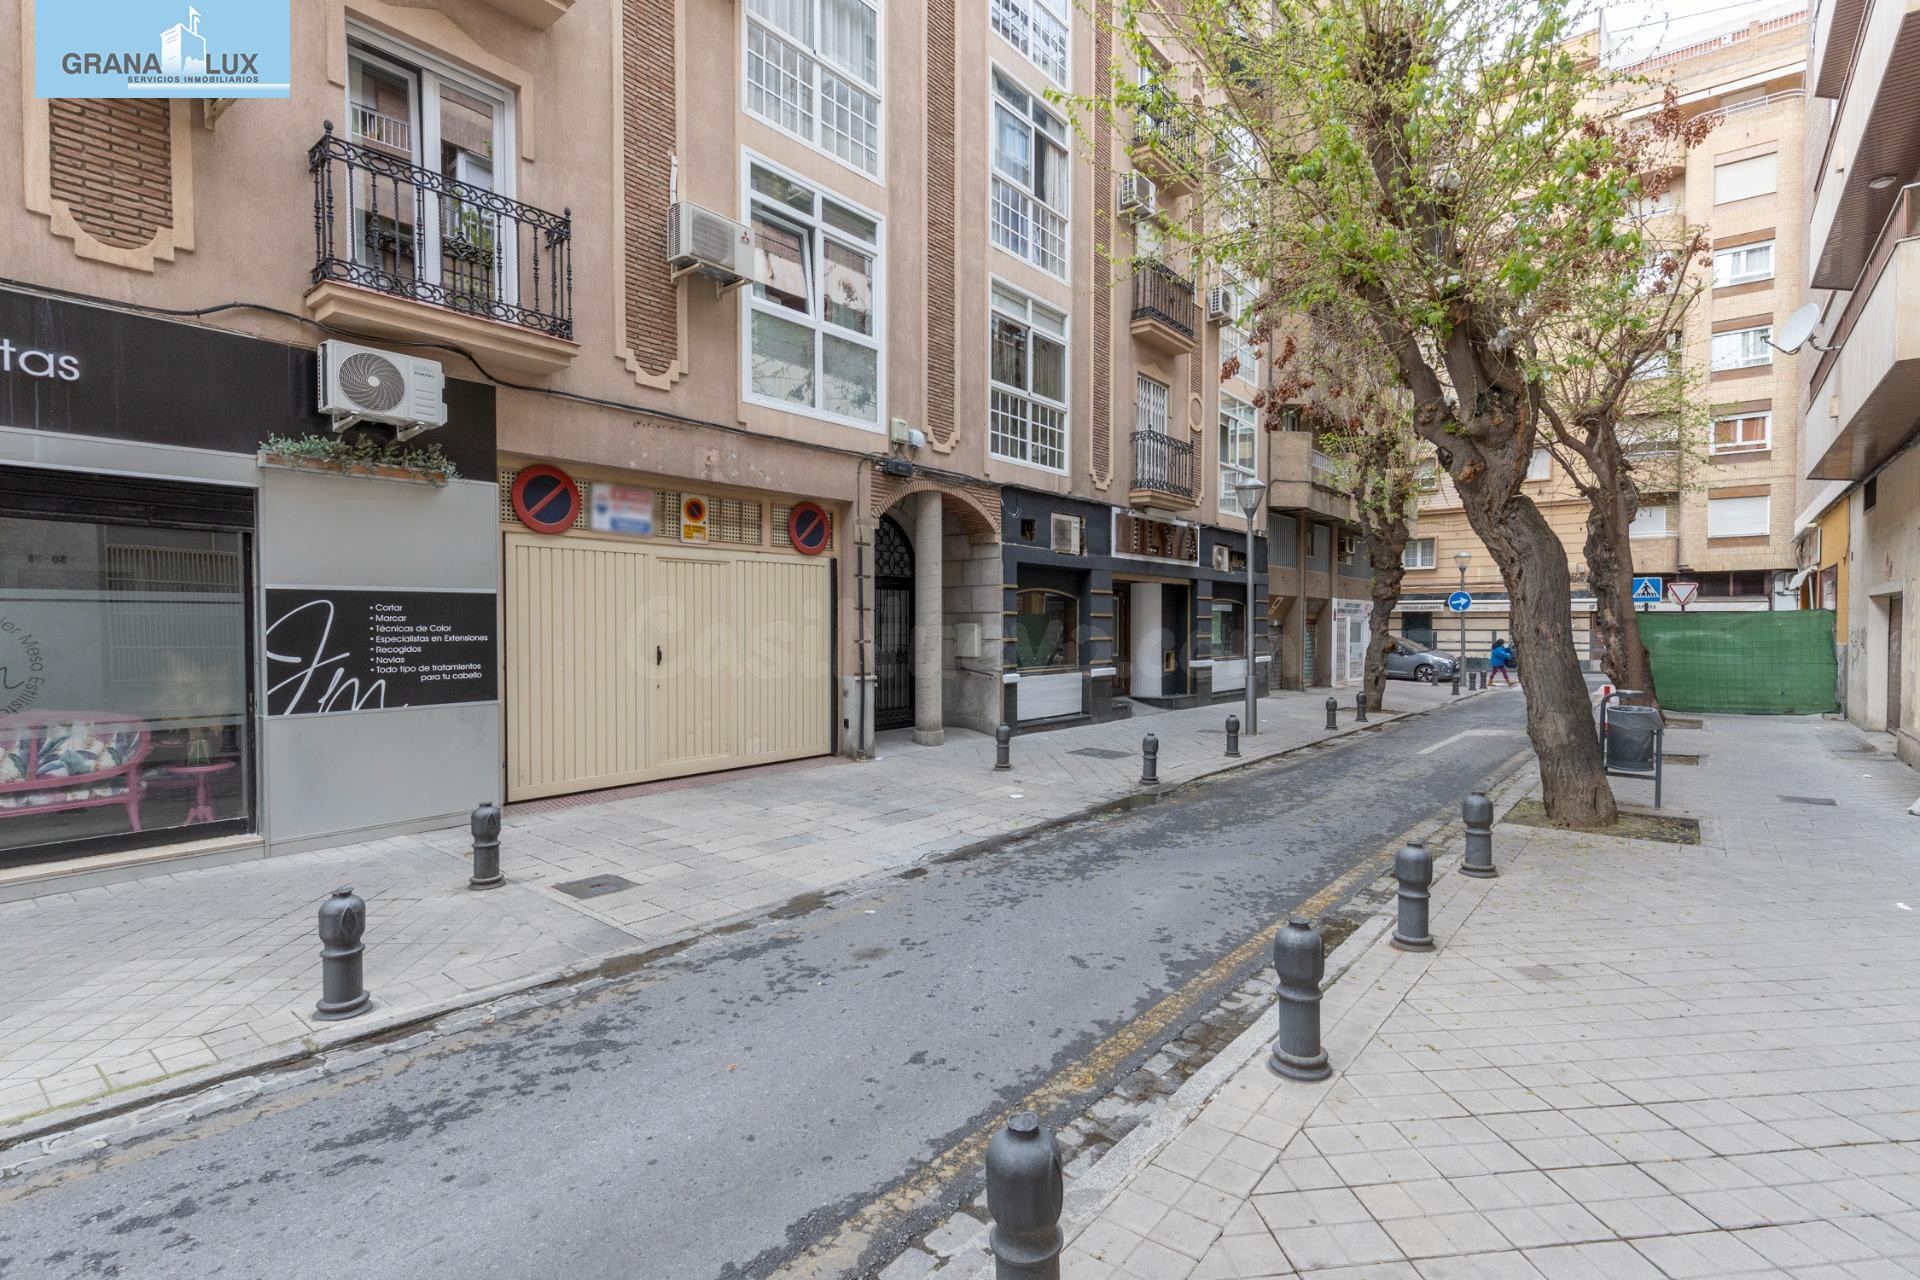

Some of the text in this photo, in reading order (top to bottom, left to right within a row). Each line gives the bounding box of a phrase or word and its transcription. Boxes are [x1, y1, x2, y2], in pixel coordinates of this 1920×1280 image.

[375, 604, 403, 612] Cortar
[375, 614, 407, 622] Marcar
[375, 624, 452, 633] Técnicas de Color
[375, 635, 430, 644] Especialistas
[444, 634, 489, 642] Extensiones
[18, 634, 44, 672] Mesa
[375, 645, 422, 655] Recogidos
[376, 663, 482, 674] Todo tipo de tratamientos
[420, 674, 441, 682] para
[452, 671, 483, 680] cabello
